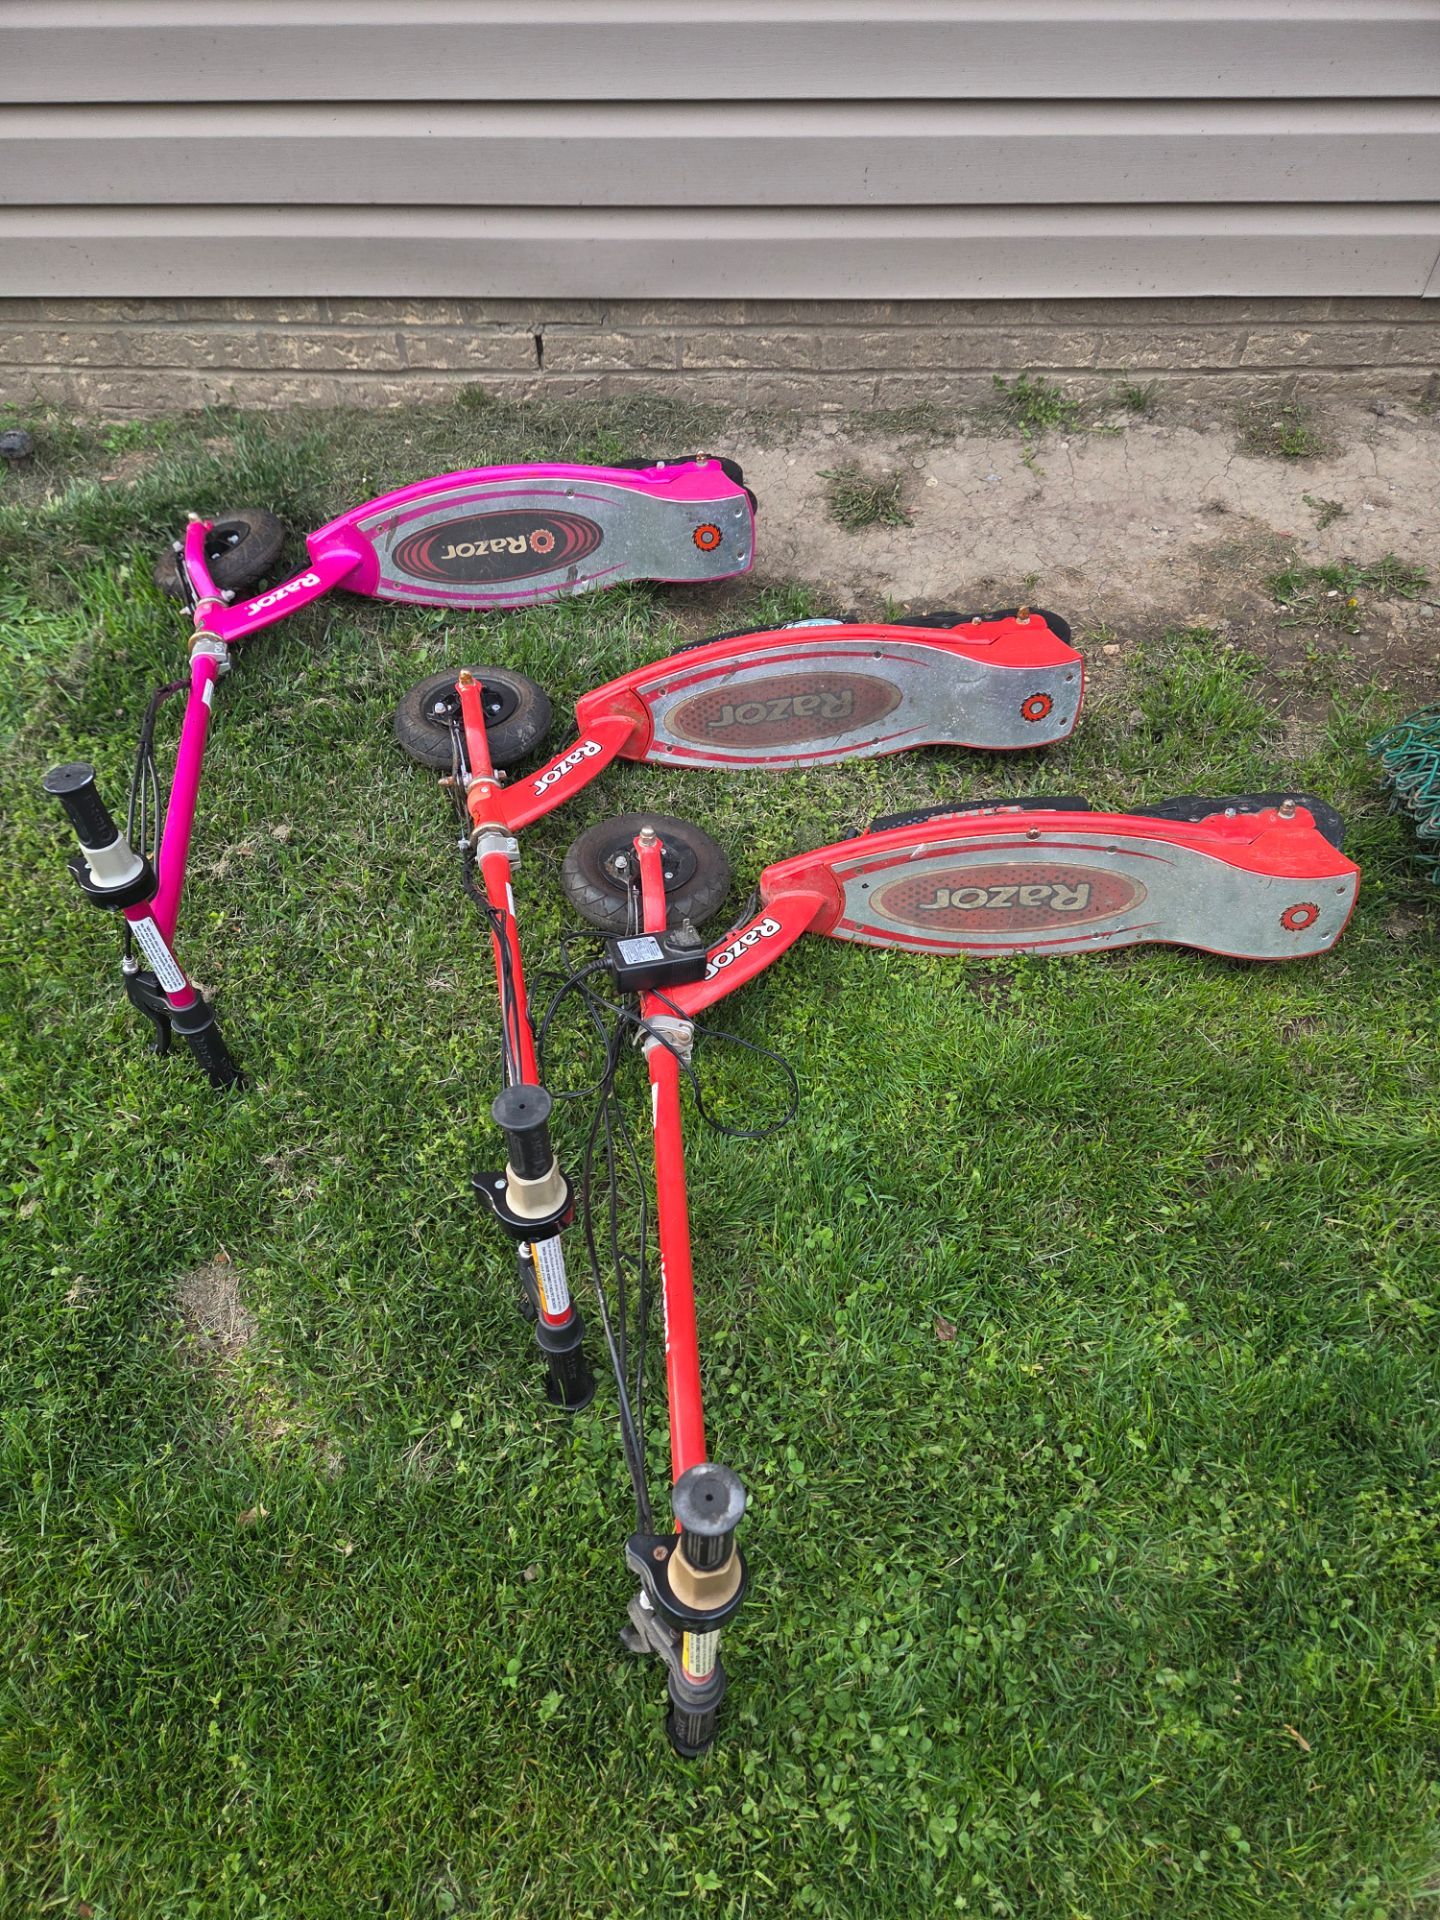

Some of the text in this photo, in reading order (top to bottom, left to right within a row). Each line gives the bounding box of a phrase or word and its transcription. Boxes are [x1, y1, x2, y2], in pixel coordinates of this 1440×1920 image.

[441, 534, 528, 560] Razor
[247, 572, 320, 616] Razor
[707, 689, 854, 728] Razor
[533, 740, 602, 796] Razor
[919, 882, 1091, 910] Razor
[704, 917, 781, 980] Razor
